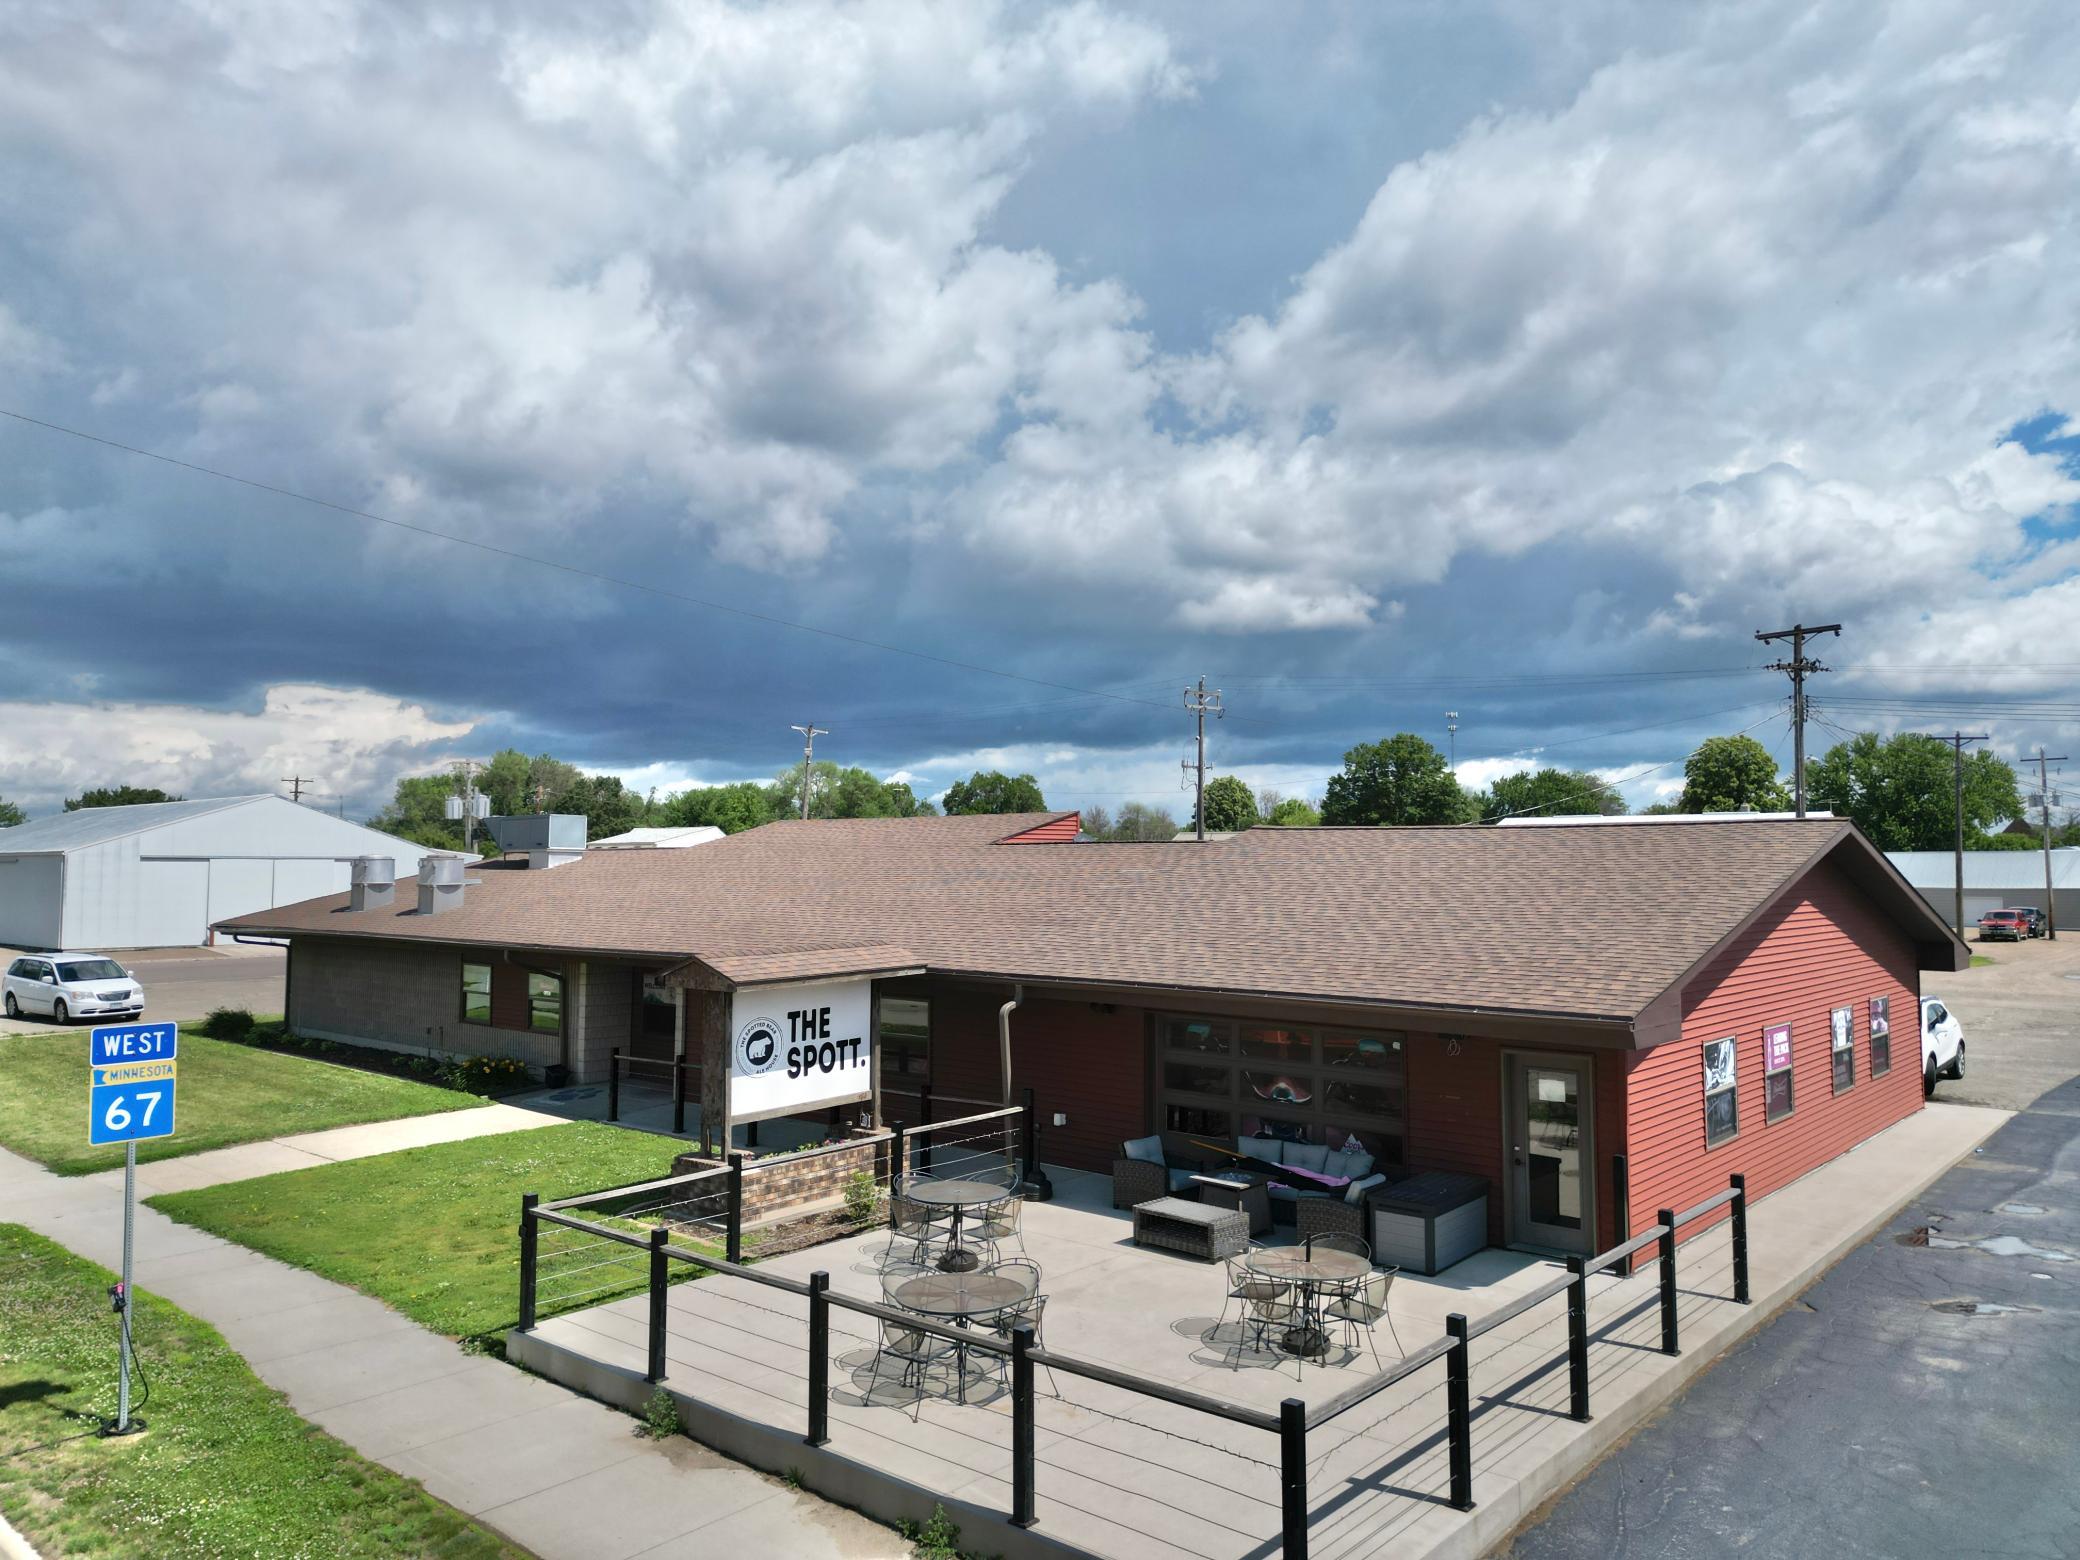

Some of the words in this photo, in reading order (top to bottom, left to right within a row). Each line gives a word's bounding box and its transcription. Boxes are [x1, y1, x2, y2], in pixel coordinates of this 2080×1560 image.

[745, 1022, 766, 1037] SPOTTED
[766, 1022, 778, 1035] BEAR
[787, 1007, 831, 1043] THE
[103, 1031, 165, 1057] WEST
[765, 1054, 779, 1071] HOUSE
[787, 1037, 866, 1080] SPOTT.
[110, 1065, 174, 1081] MINNESOTA
[105, 1091, 162, 1131] 67
